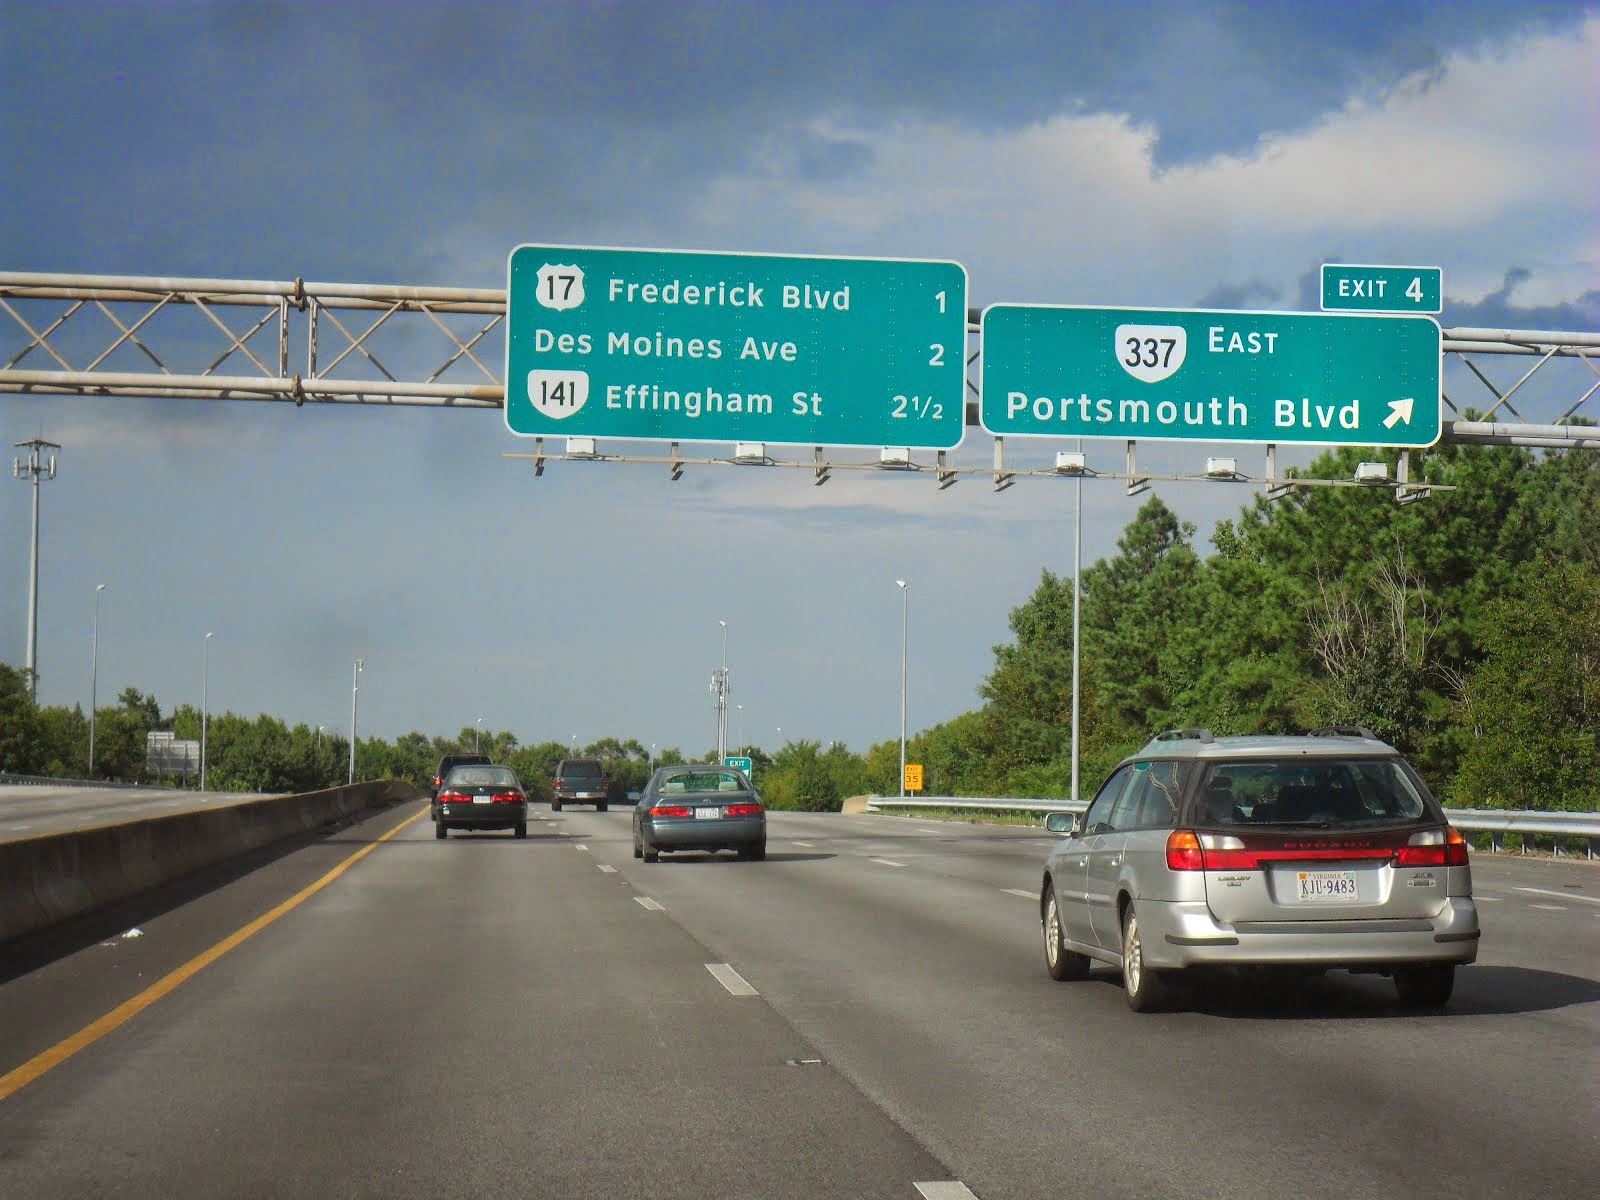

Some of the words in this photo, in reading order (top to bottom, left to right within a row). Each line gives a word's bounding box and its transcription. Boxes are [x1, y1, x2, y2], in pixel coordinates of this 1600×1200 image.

[547, 275, 576, 300] 17
[609, 278, 764, 307] Frederick
[782, 285, 850, 311] Blvd
[1338, 279, 1388, 298] EXIT
[1405, 277, 1424, 303] 4
[934, 291, 946, 313] 1
[535, 329, 592, 355] Des
[608, 331, 722, 359] Moines
[740, 337, 797, 362] Ave
[1125, 337, 1177, 368] 337
[1208, 326, 1279, 354] EAST
[929, 343, 945, 366] 2
[540, 380, 575, 407] 141
[606, 384, 773, 418] Effingham
[792, 391, 823, 416] St
[1007, 391, 1248, 426] Portsmouth
[1274, 398, 1360, 429] Blvd
[1301, 879, 1355, 895] KJU-9483
